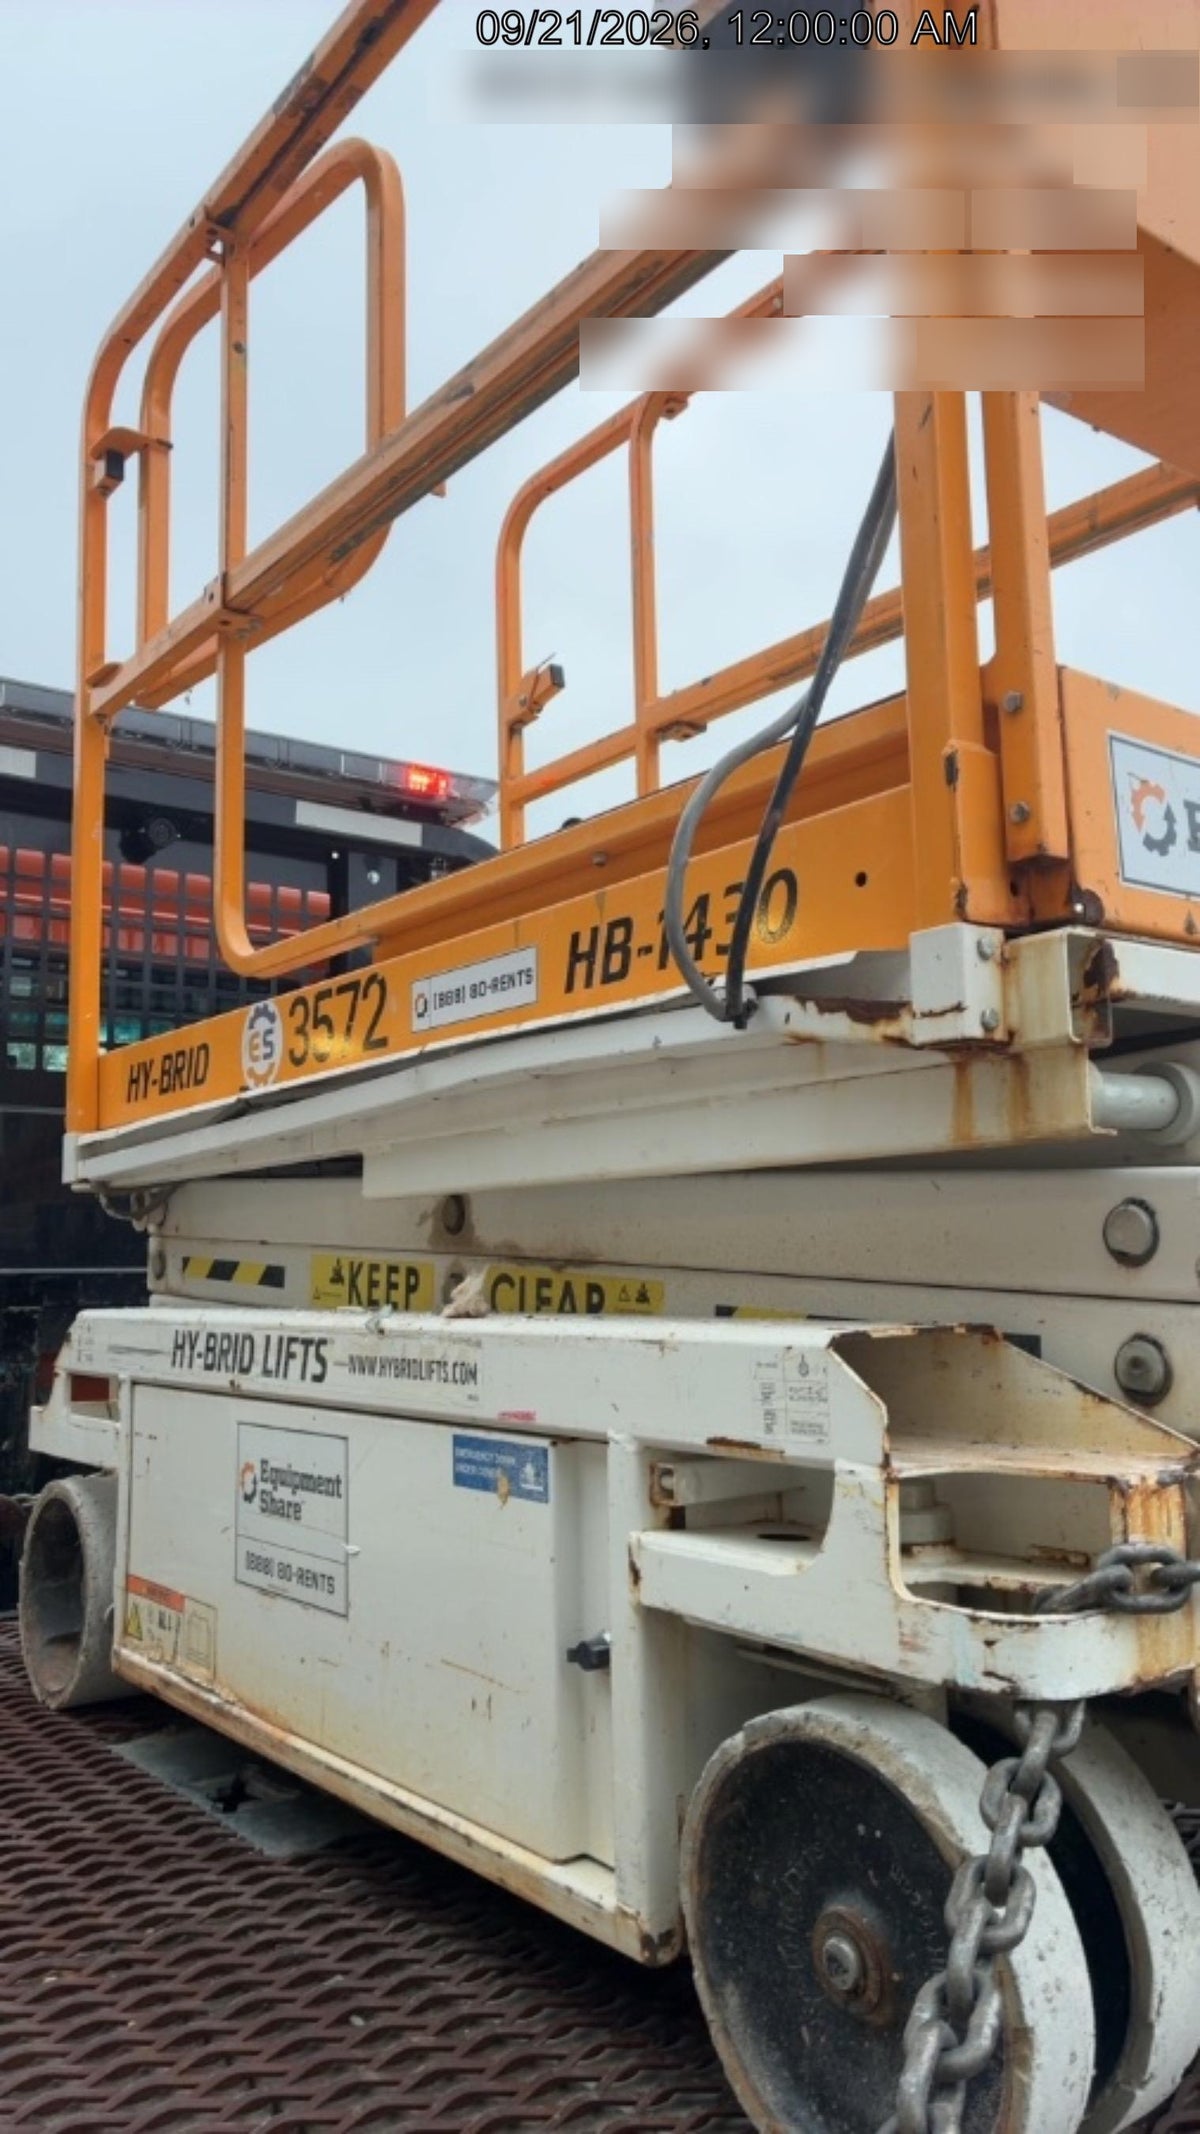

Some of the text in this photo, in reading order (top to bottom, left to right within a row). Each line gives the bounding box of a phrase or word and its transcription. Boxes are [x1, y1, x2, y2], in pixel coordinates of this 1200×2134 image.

[288, 972, 388, 1067] 3572
[127, 1042, 210, 1104] HY-BRID
[348, 1260, 421, 1311] KEEP
[171, 1329, 328, 1383] HY-BRID LIFTS
[348, 1354, 478, 1386] WWW.HYBRIDLIFTS.COM
[260, 1458, 342, 1499] Equipment
[260, 1490, 303, 1521] Share
